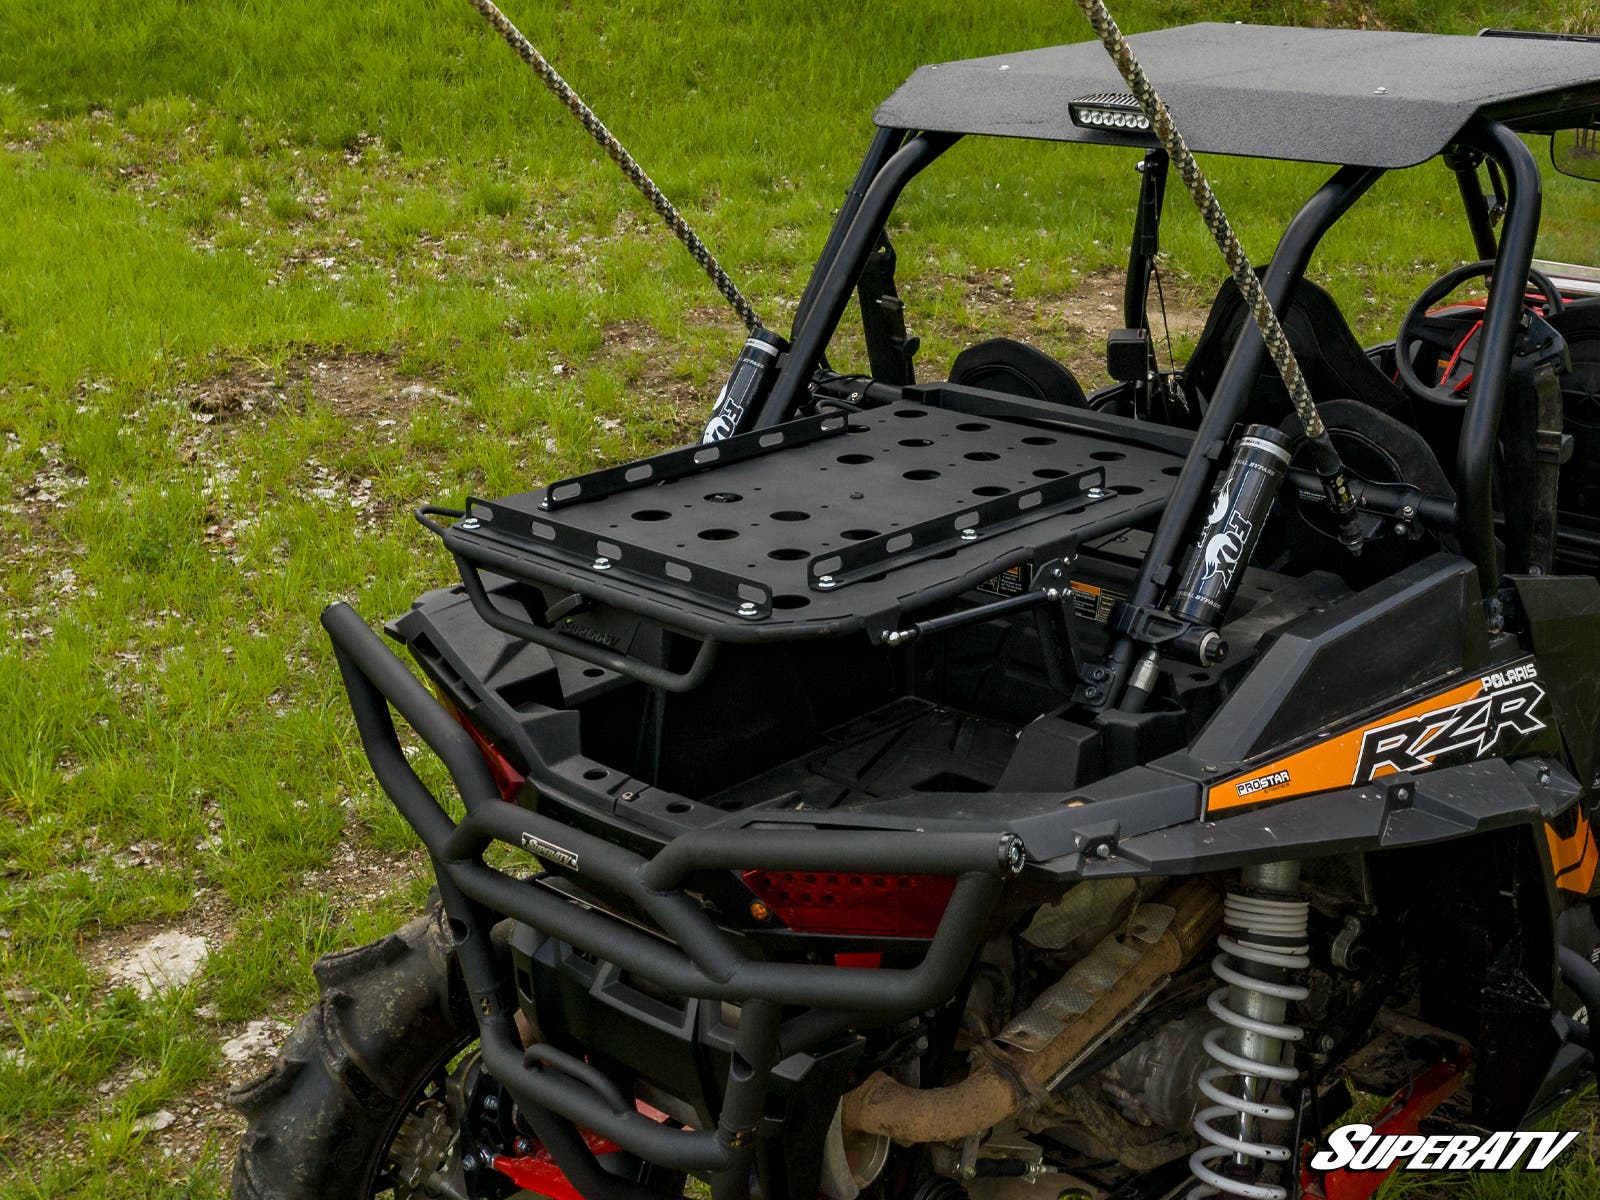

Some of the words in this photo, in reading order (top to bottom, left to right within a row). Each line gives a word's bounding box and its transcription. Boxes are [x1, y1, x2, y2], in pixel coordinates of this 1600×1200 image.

[1203, 510, 1253, 590] FOX
[1480, 663, 1537, 692] POLARIS
[1352, 682, 1547, 786] RZR
[1236, 771, 1290, 796] PROSTAR
